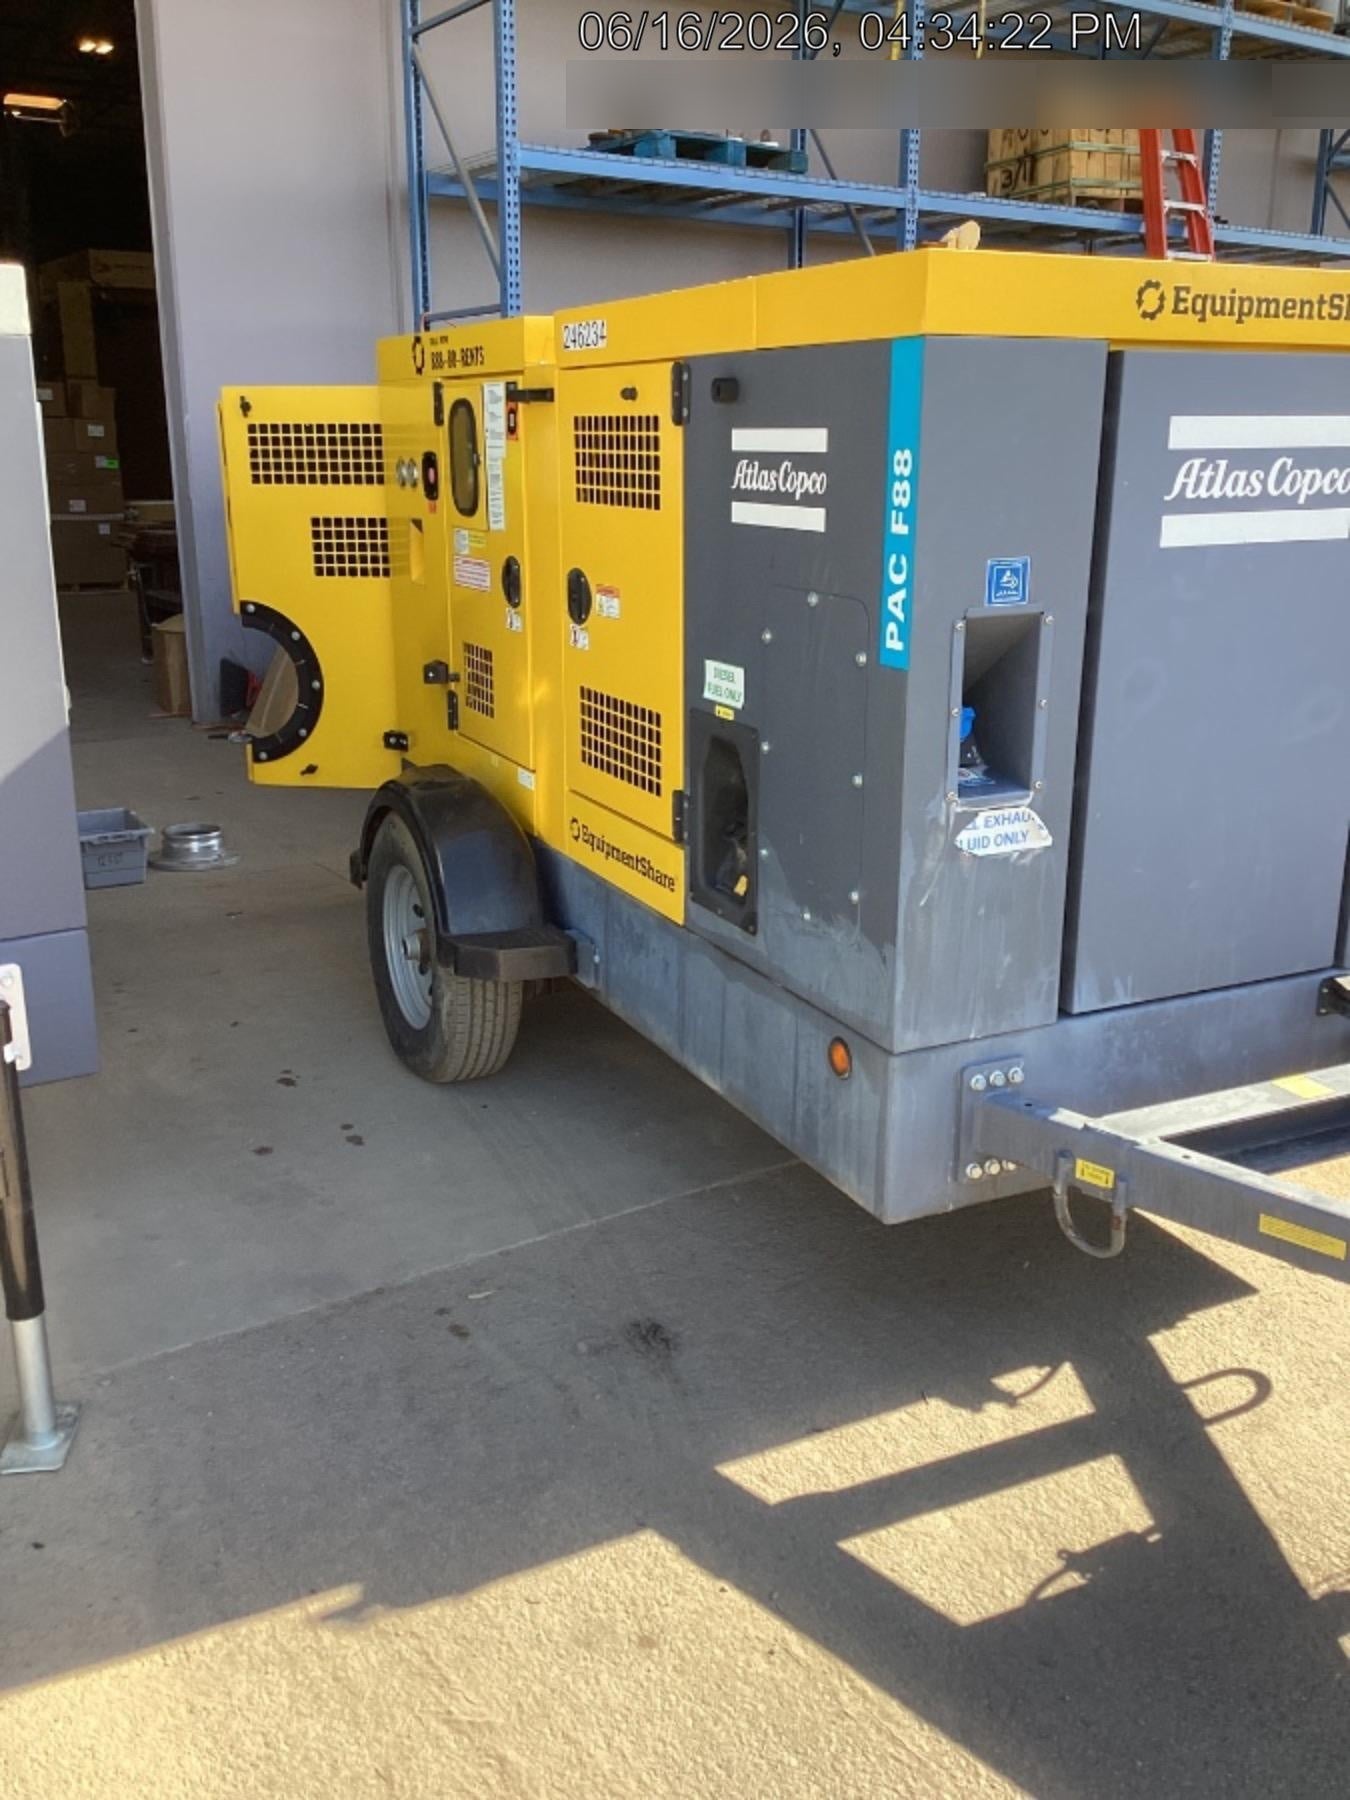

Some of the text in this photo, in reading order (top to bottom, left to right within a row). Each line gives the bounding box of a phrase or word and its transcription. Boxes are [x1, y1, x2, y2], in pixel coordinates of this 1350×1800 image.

[563, 321, 606, 350] 246234
[885, 447, 912, 651] PAC F88
[983, 810, 1033, 829] EXHAU
[993, 829, 1030, 847] ONLY
[581, 823, 676, 893] EquipmentShare
